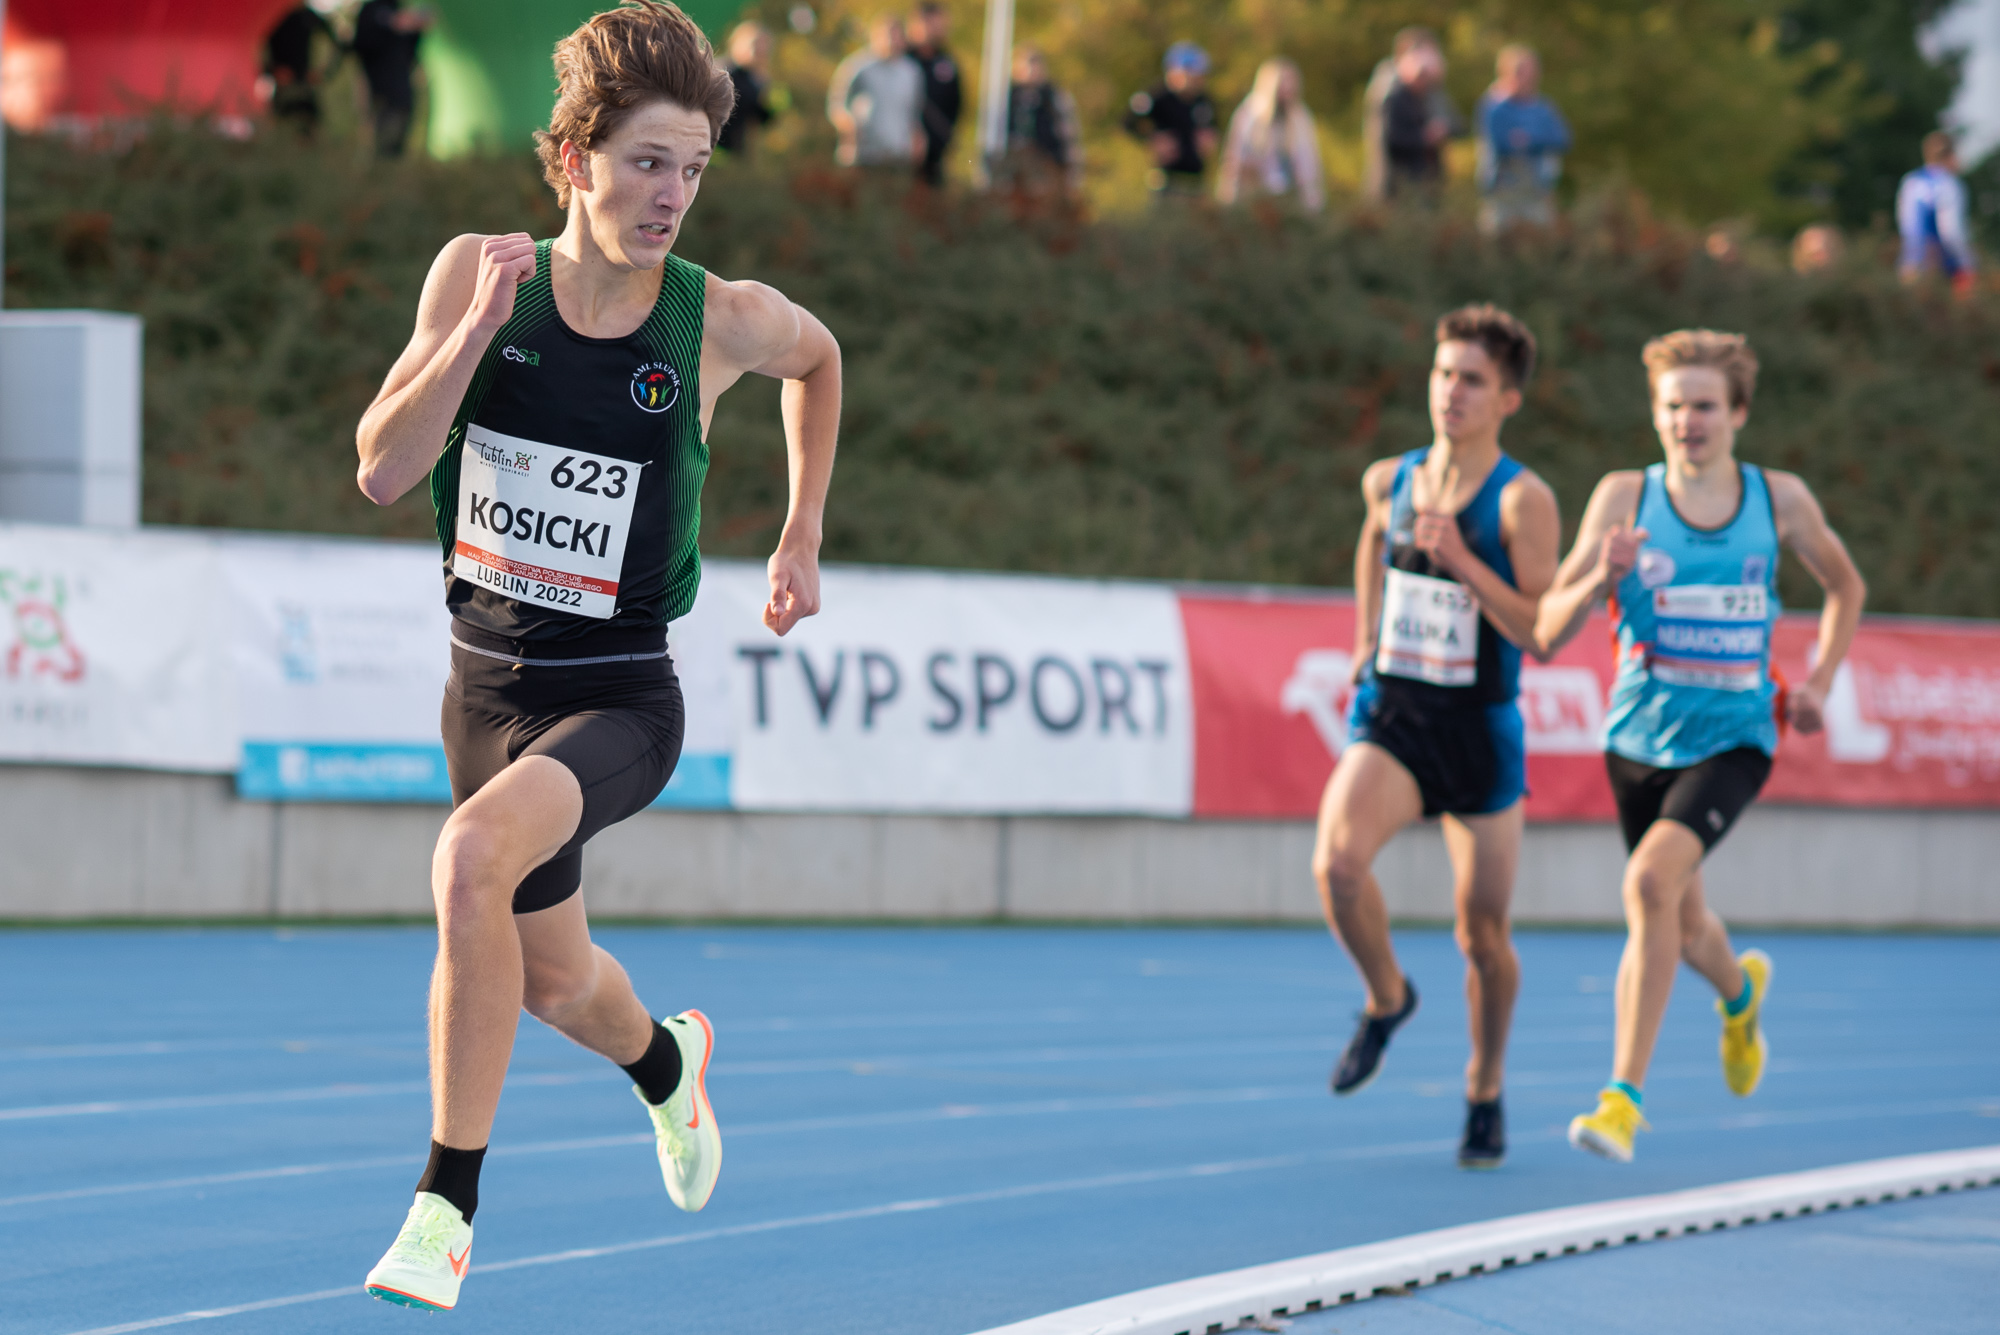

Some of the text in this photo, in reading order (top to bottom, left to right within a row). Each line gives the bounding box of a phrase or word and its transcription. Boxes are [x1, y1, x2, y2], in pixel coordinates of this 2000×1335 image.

[632, 363, 651, 380] AML
[550, 455, 628, 499] 623
[470, 492, 611, 558] KOSICKI
[477, 564, 583, 608] LUBLIN 2022
[496, 556, 541, 574] MISTRZOSTWA
[542, 569, 568, 580] POLSKI
[569, 574, 582, 583] U16
[511, 567, 544, 581] JANUSZA
[738, 645, 1171, 738] TVP SPORT
